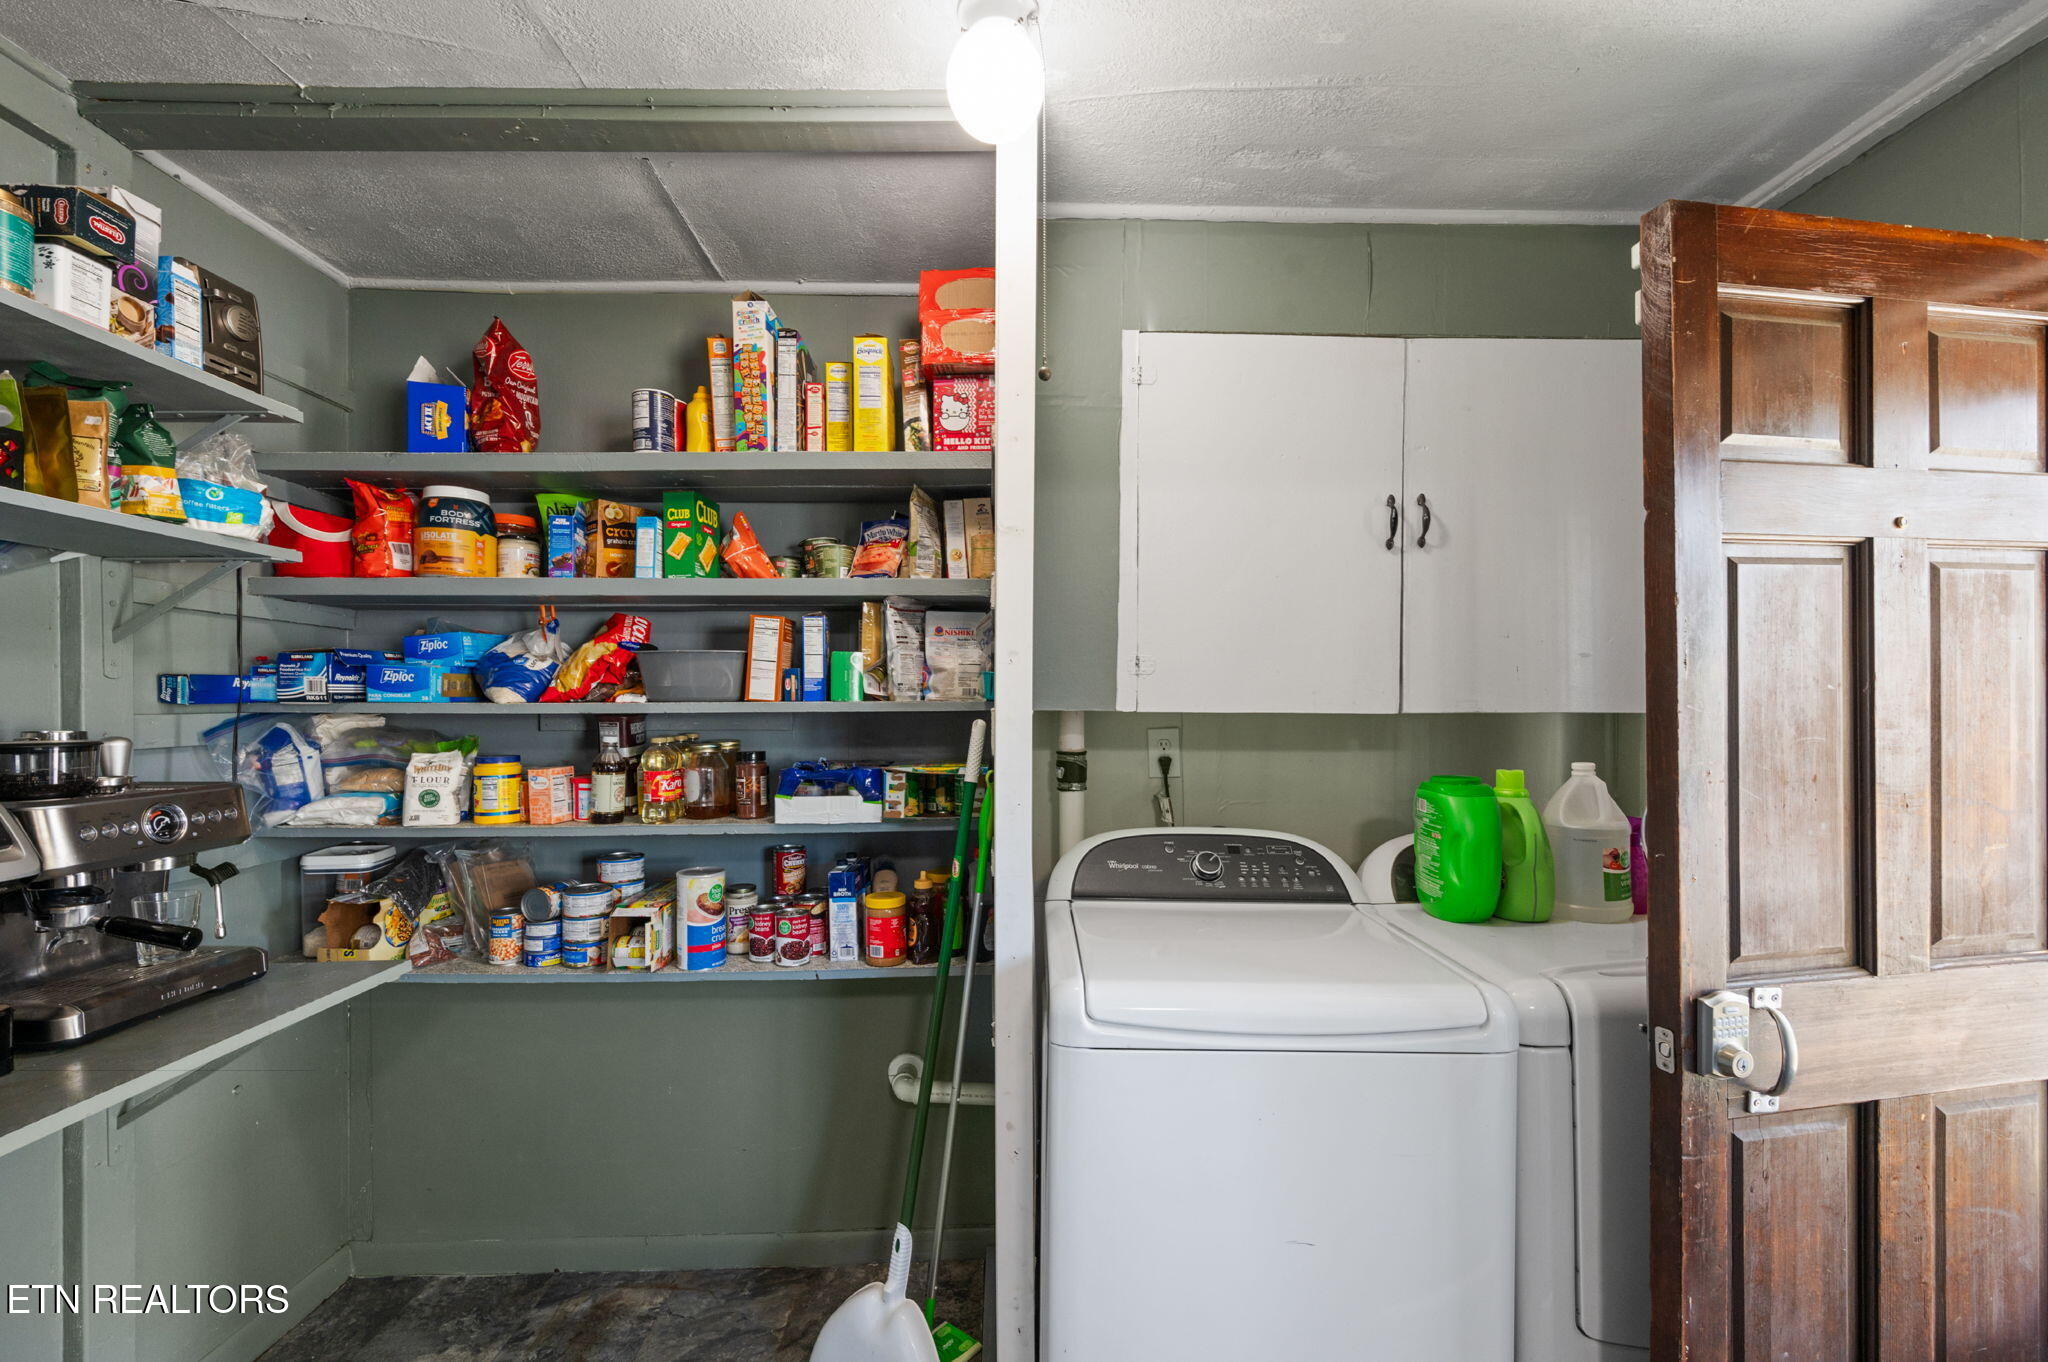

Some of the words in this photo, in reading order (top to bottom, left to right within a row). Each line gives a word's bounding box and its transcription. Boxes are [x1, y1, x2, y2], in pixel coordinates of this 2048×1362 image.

[943, 437, 972, 445] HELLO
[973, 437, 991, 445] KIT
[182, 499, 204, 508] offee
[441, 510, 472, 519] BODY
[667, 508, 691, 520] CLUB
[696, 500, 719, 528] CLUB
[429, 516, 480, 528] FORTRESS
[419, 640, 448, 653] Ziploc
[383, 670, 415, 683] Ziploc
[411, 776, 450, 784] FLOUR
[660, 779, 682, 791] Karo
